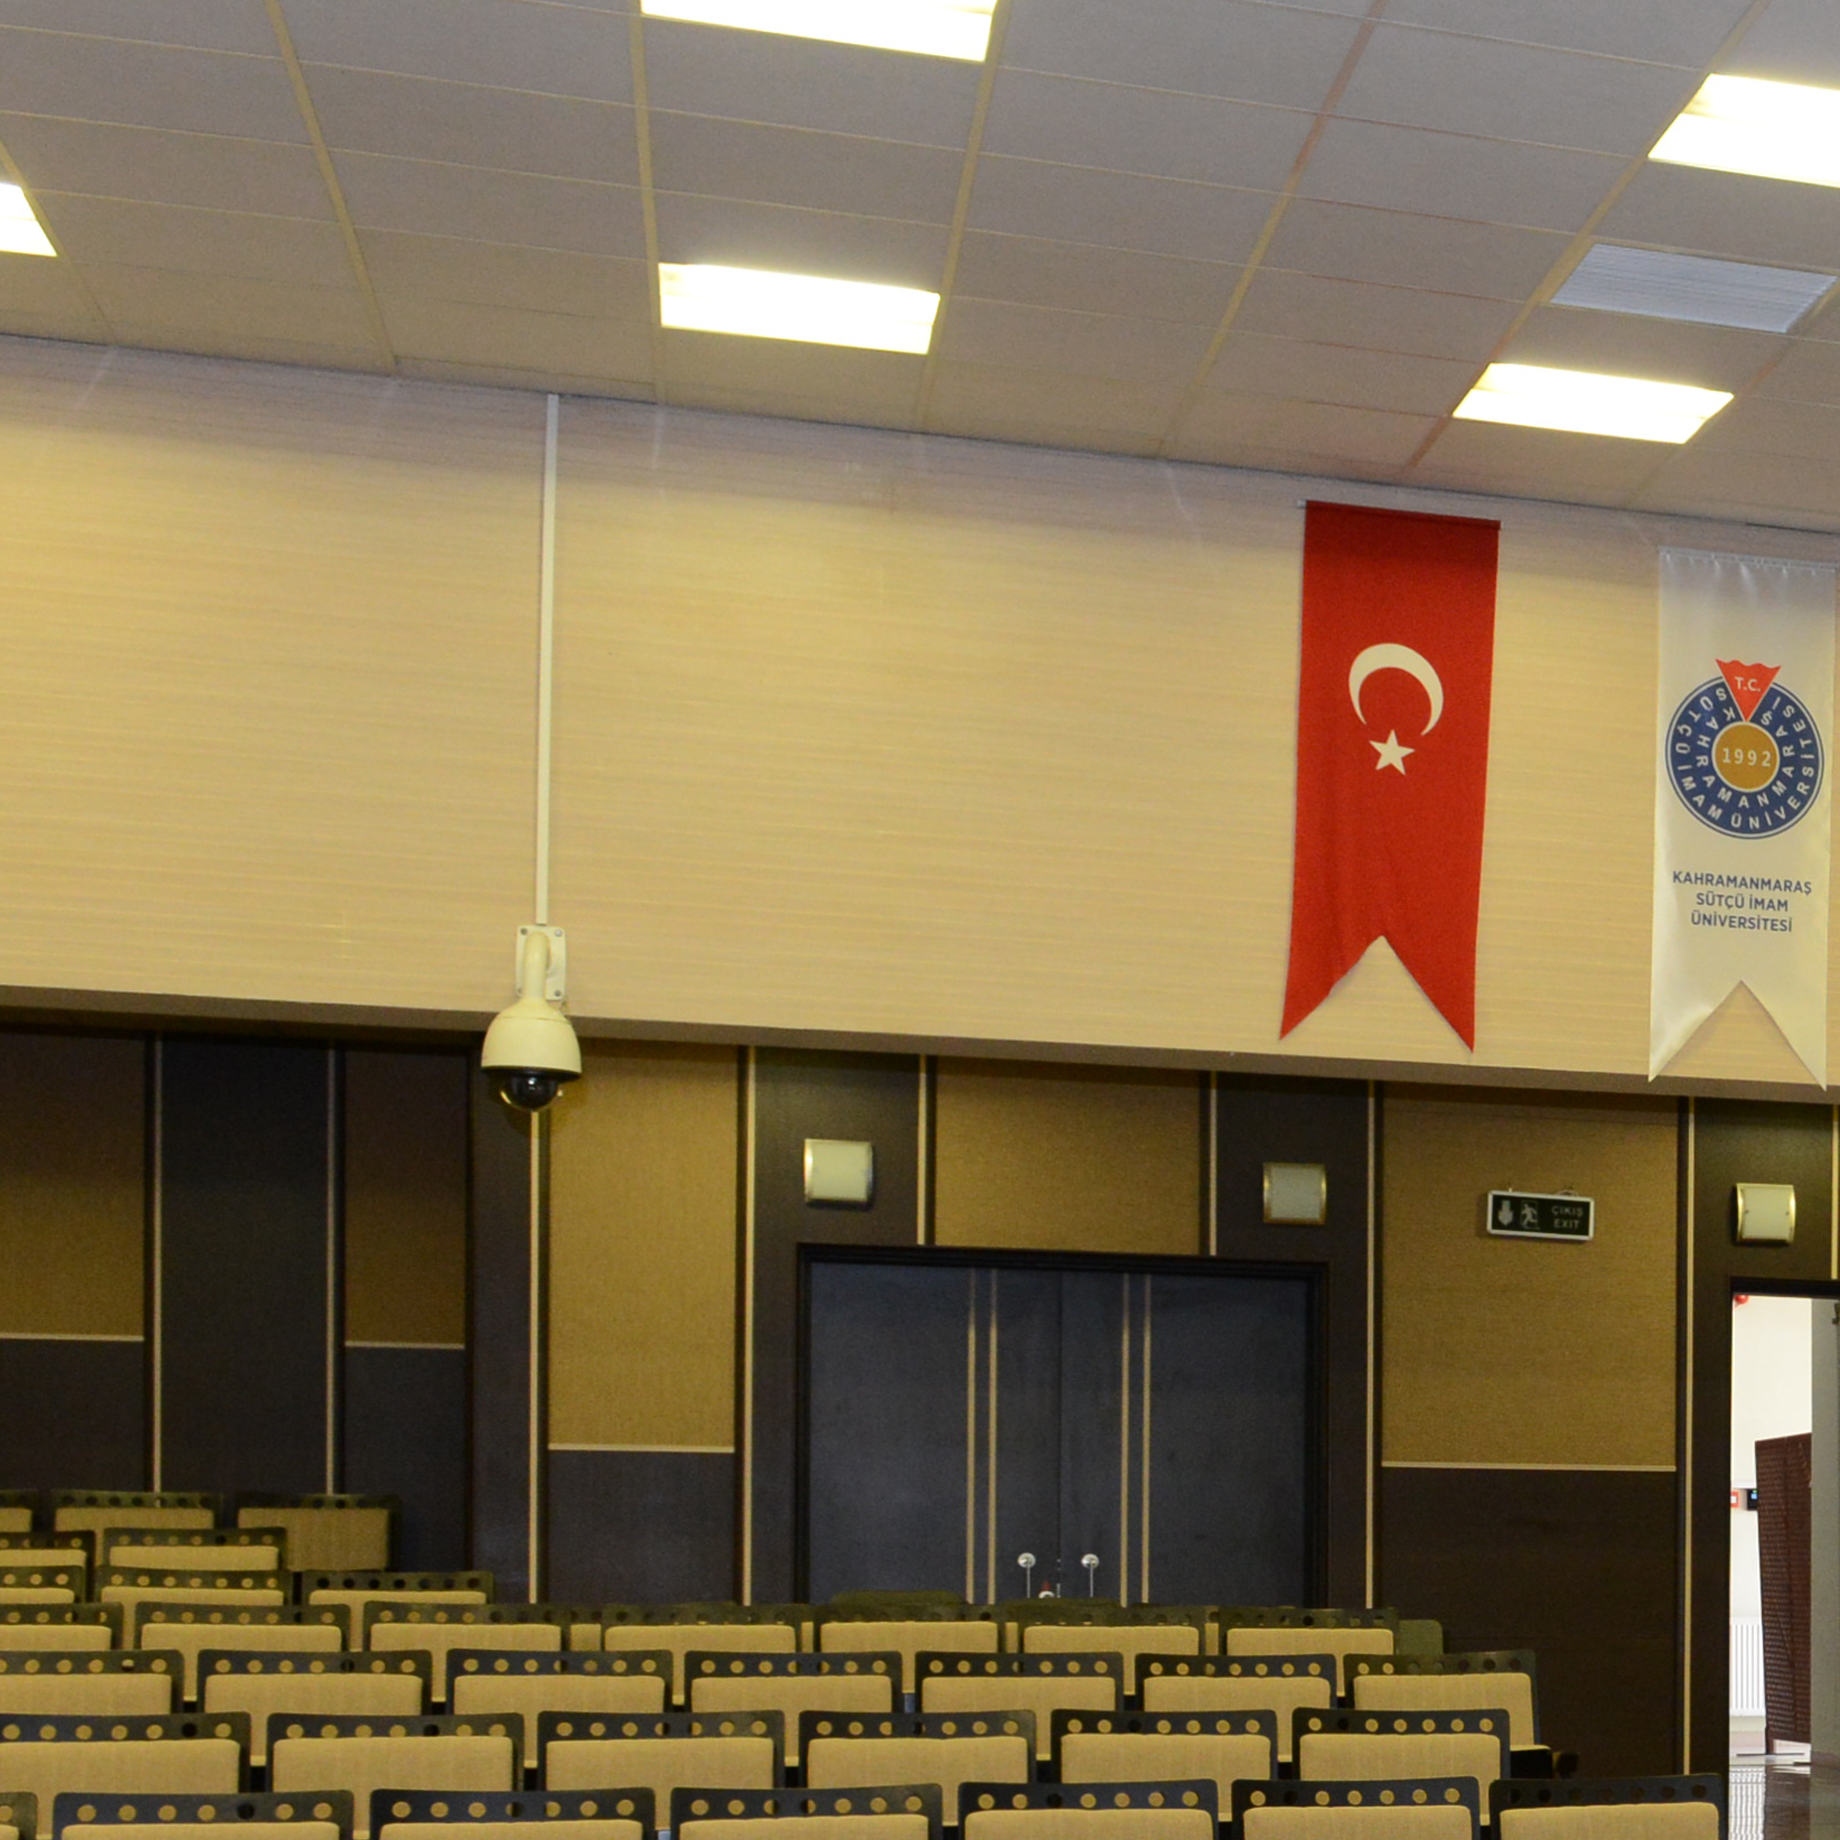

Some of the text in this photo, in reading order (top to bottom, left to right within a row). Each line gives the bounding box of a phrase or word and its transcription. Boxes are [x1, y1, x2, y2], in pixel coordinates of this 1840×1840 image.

[1734, 676, 1761, 692] T.C.
[1696, 706, 1796, 809] KAHRAMANMARAŞ
[1722, 747, 1772, 768] 1992
[1731, 696, 1815, 829] ÜNİVERSİTESİ
[1672, 870, 1812, 896] KAHRAMANMARAŞ
[1696, 890, 1789, 912] SÜTÇÜ İMAM
[1691, 909, 1793, 932] ÜNİVERSİTESİ
[1551, 1205, 1583, 1217] ÇIKIŞ
[1554, 1219, 1580, 1229] EXIT
